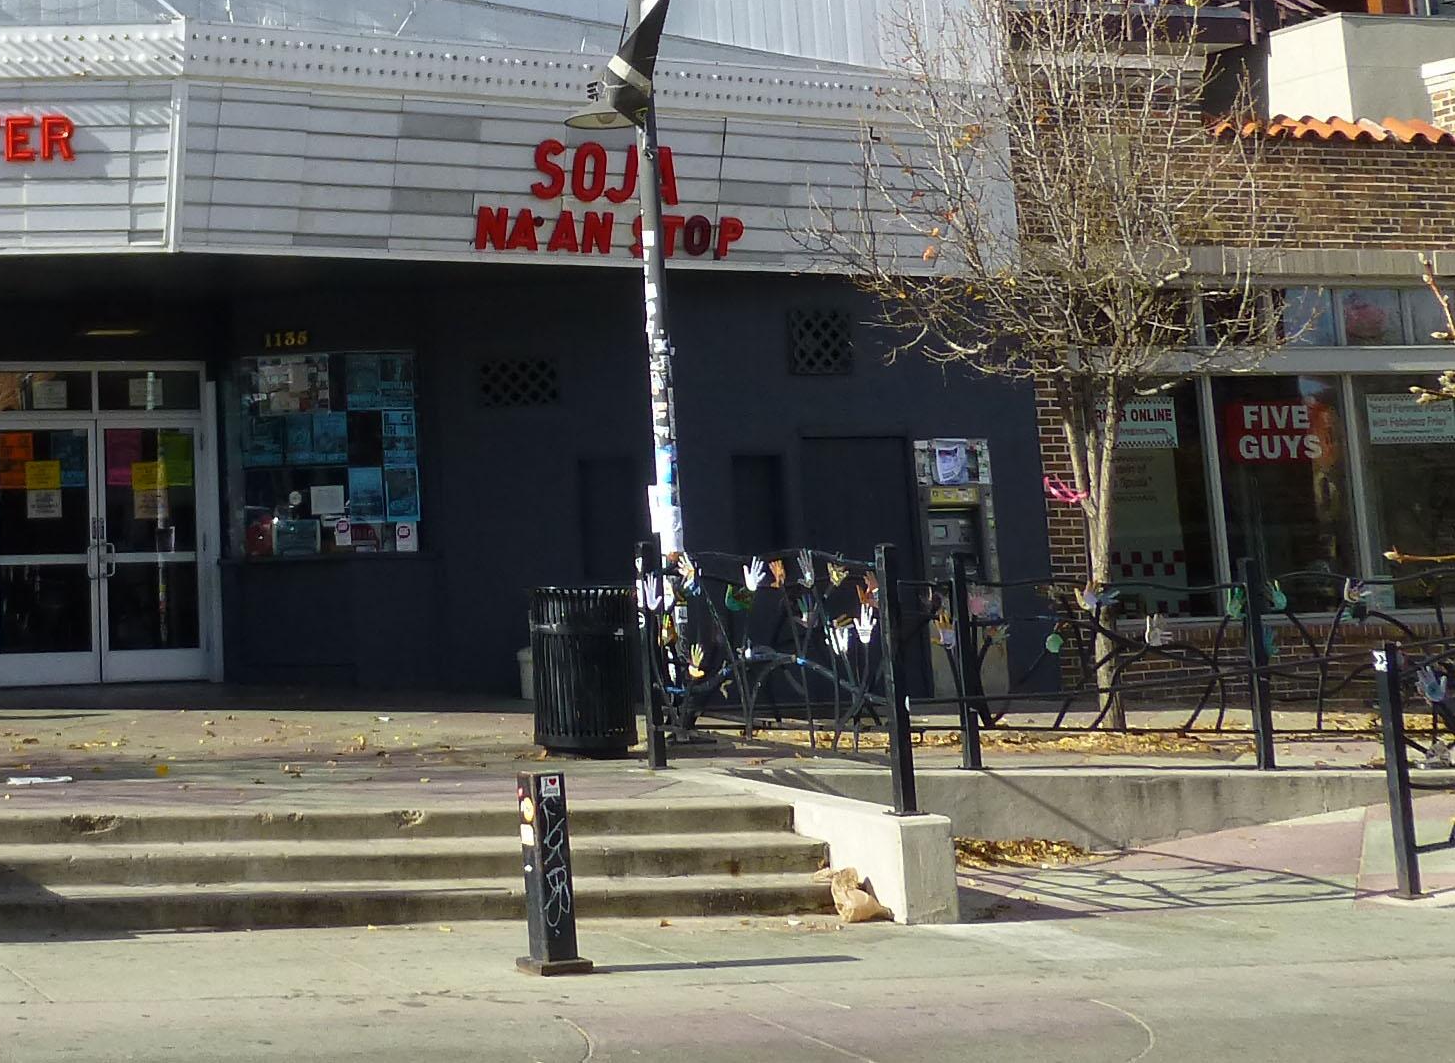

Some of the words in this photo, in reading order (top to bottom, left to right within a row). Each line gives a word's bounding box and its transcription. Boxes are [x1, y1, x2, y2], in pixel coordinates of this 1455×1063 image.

[1130, 408, 1173, 423] ONLINE
[1243, 405, 1311, 430] FIVE
[1238, 434, 1323, 460] GUYS
